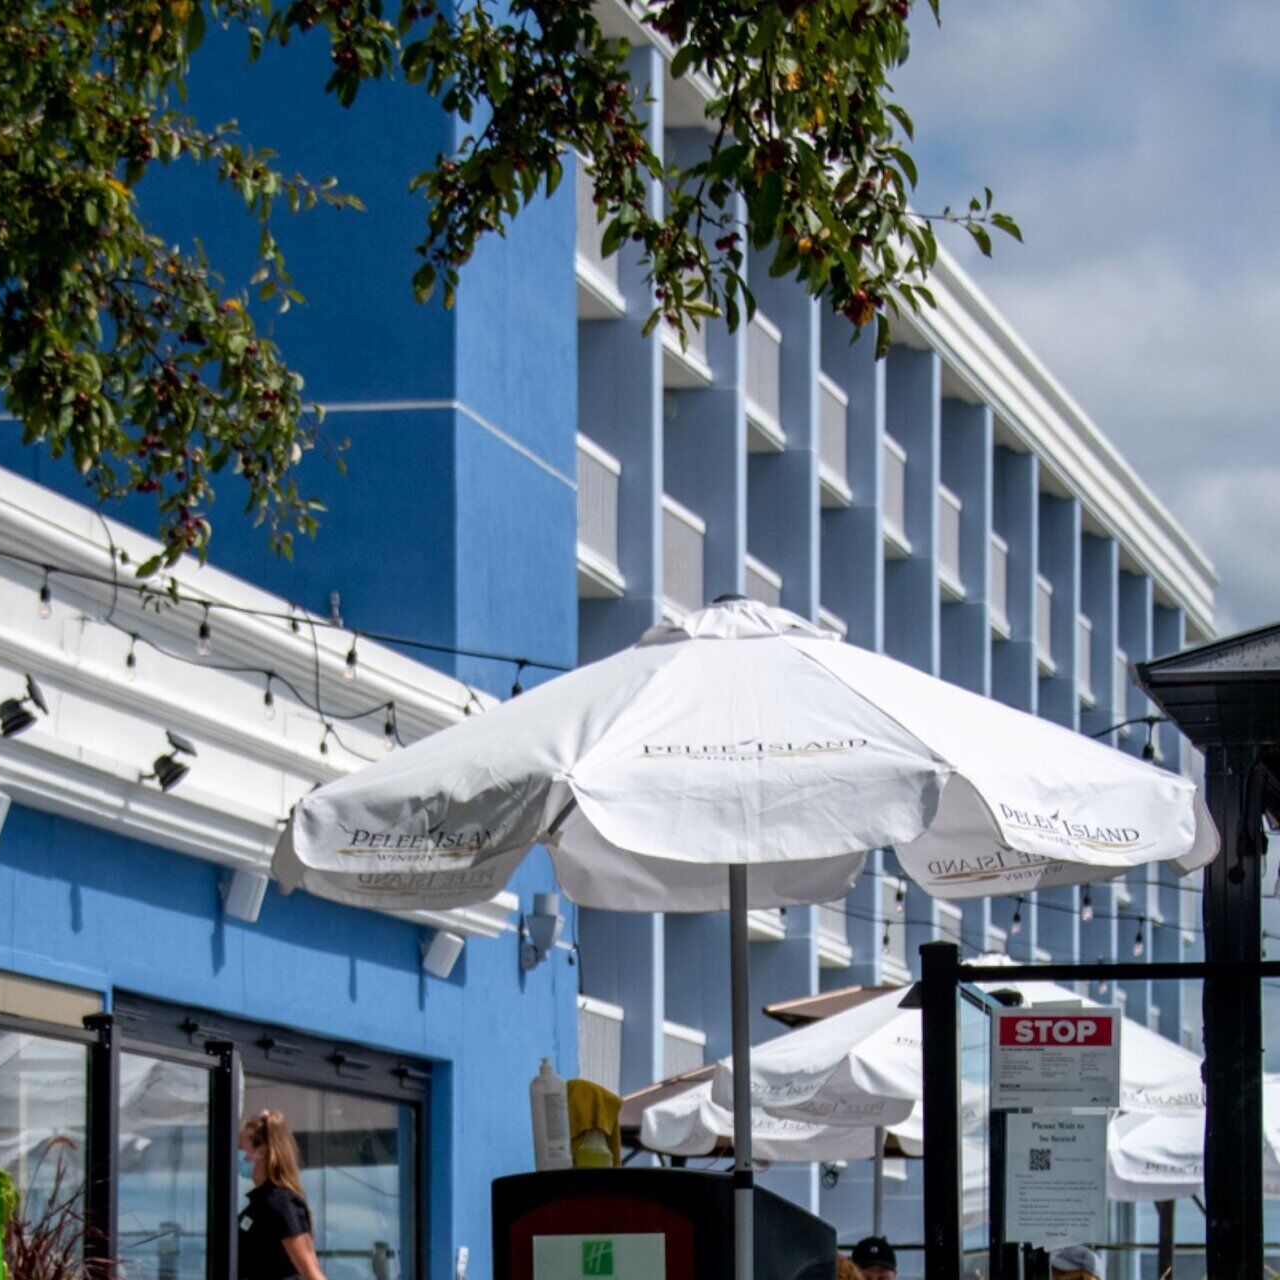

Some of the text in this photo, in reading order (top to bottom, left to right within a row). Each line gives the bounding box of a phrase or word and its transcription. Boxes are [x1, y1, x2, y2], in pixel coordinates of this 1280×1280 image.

[756, 738, 868, 752] ISLAND
[350, 828, 425, 849] PELEE
[1062, 819, 1140, 843] ISLAND
[1015, 1019, 1098, 1043] STOP
